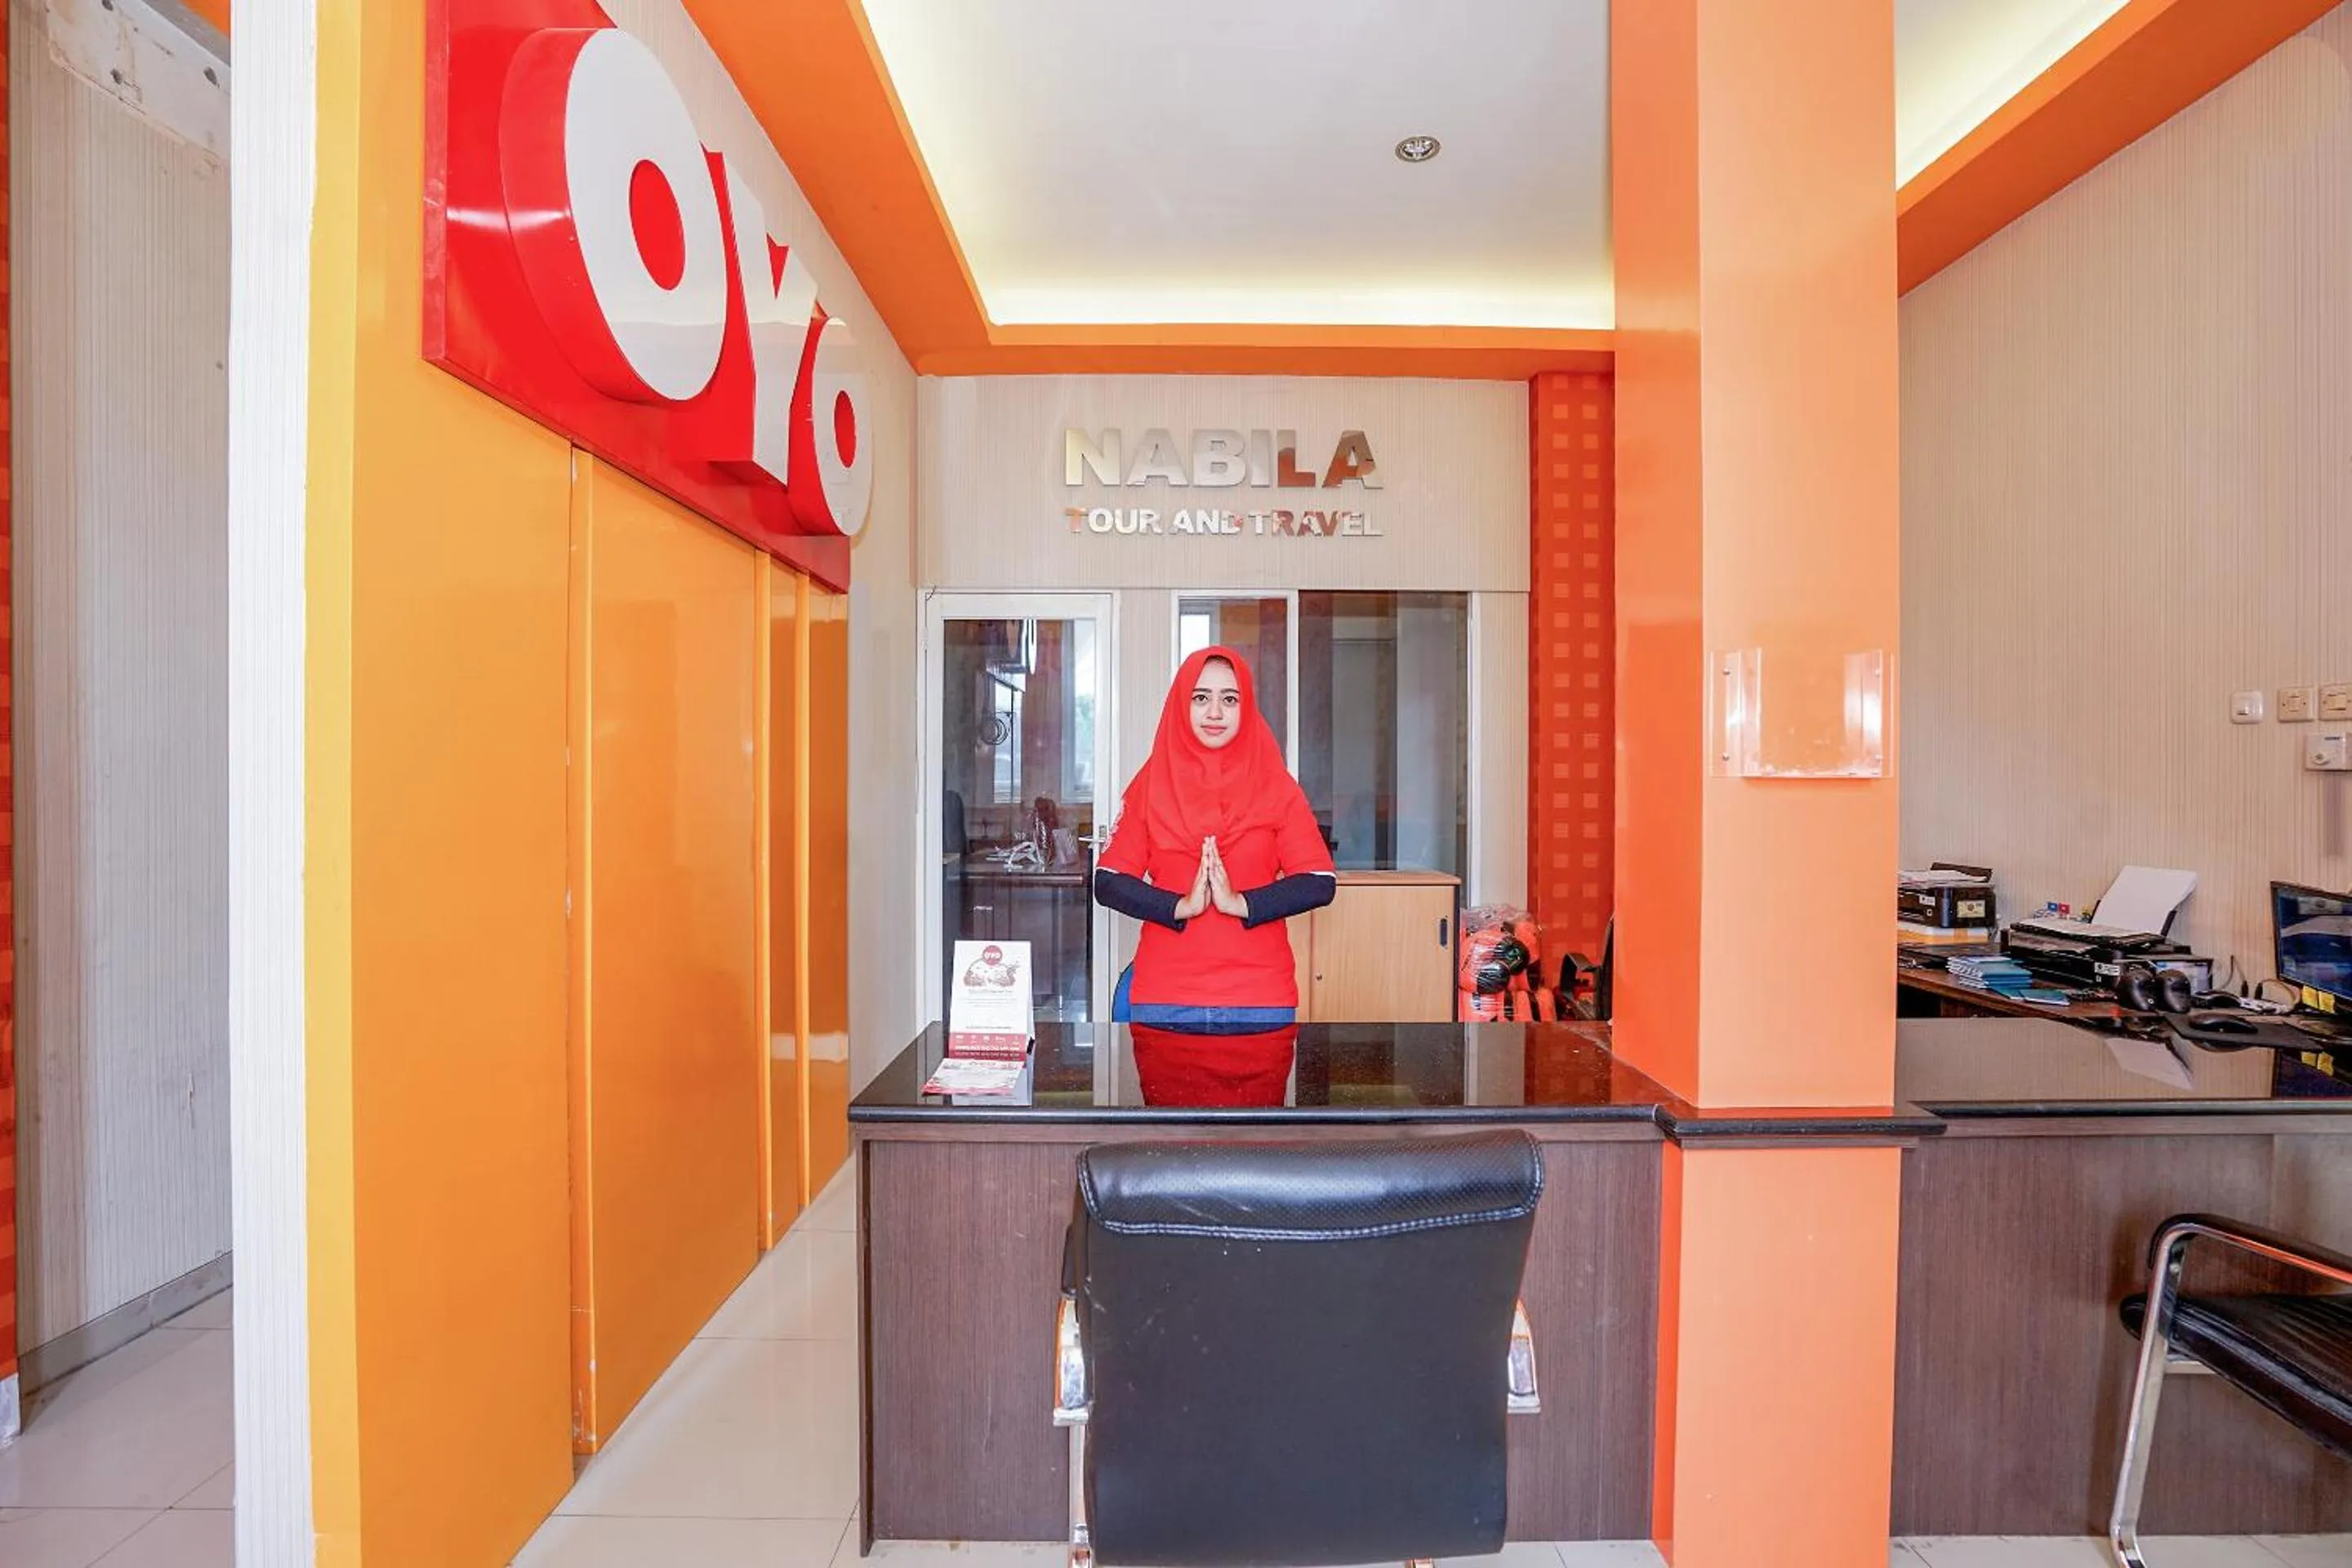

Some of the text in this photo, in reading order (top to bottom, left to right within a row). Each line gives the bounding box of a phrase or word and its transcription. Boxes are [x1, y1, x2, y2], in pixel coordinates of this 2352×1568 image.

[564, 28, 872, 536] OYO
[1064, 428, 1384, 489] NABILA
[1064, 506, 1384, 537] TOUR AND TRAVEL
